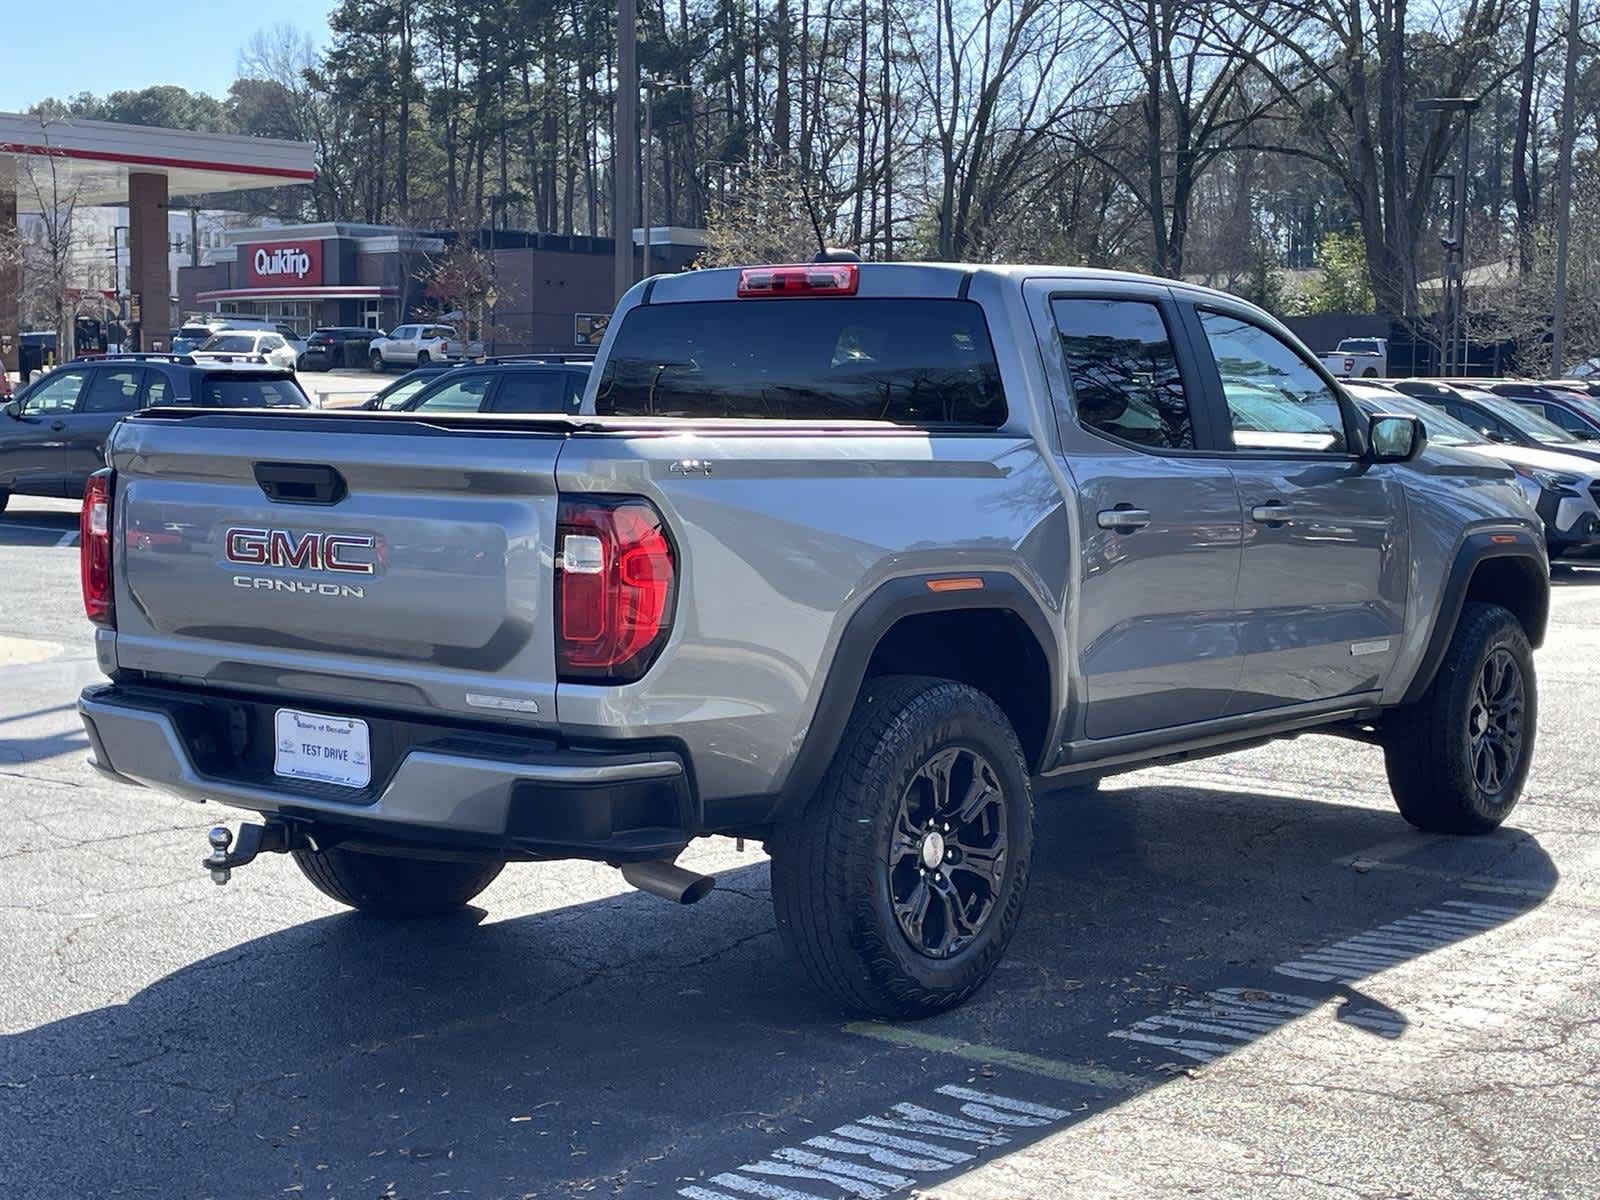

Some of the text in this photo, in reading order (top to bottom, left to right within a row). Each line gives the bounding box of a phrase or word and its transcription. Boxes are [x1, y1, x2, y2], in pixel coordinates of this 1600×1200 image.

[254, 248, 310, 279] QuikTrip
[225, 527, 374, 574] GMC
[233, 575, 364, 598] CANYON
[302, 744, 321, 757] TEST
[324, 747, 348, 761] DRIVE
